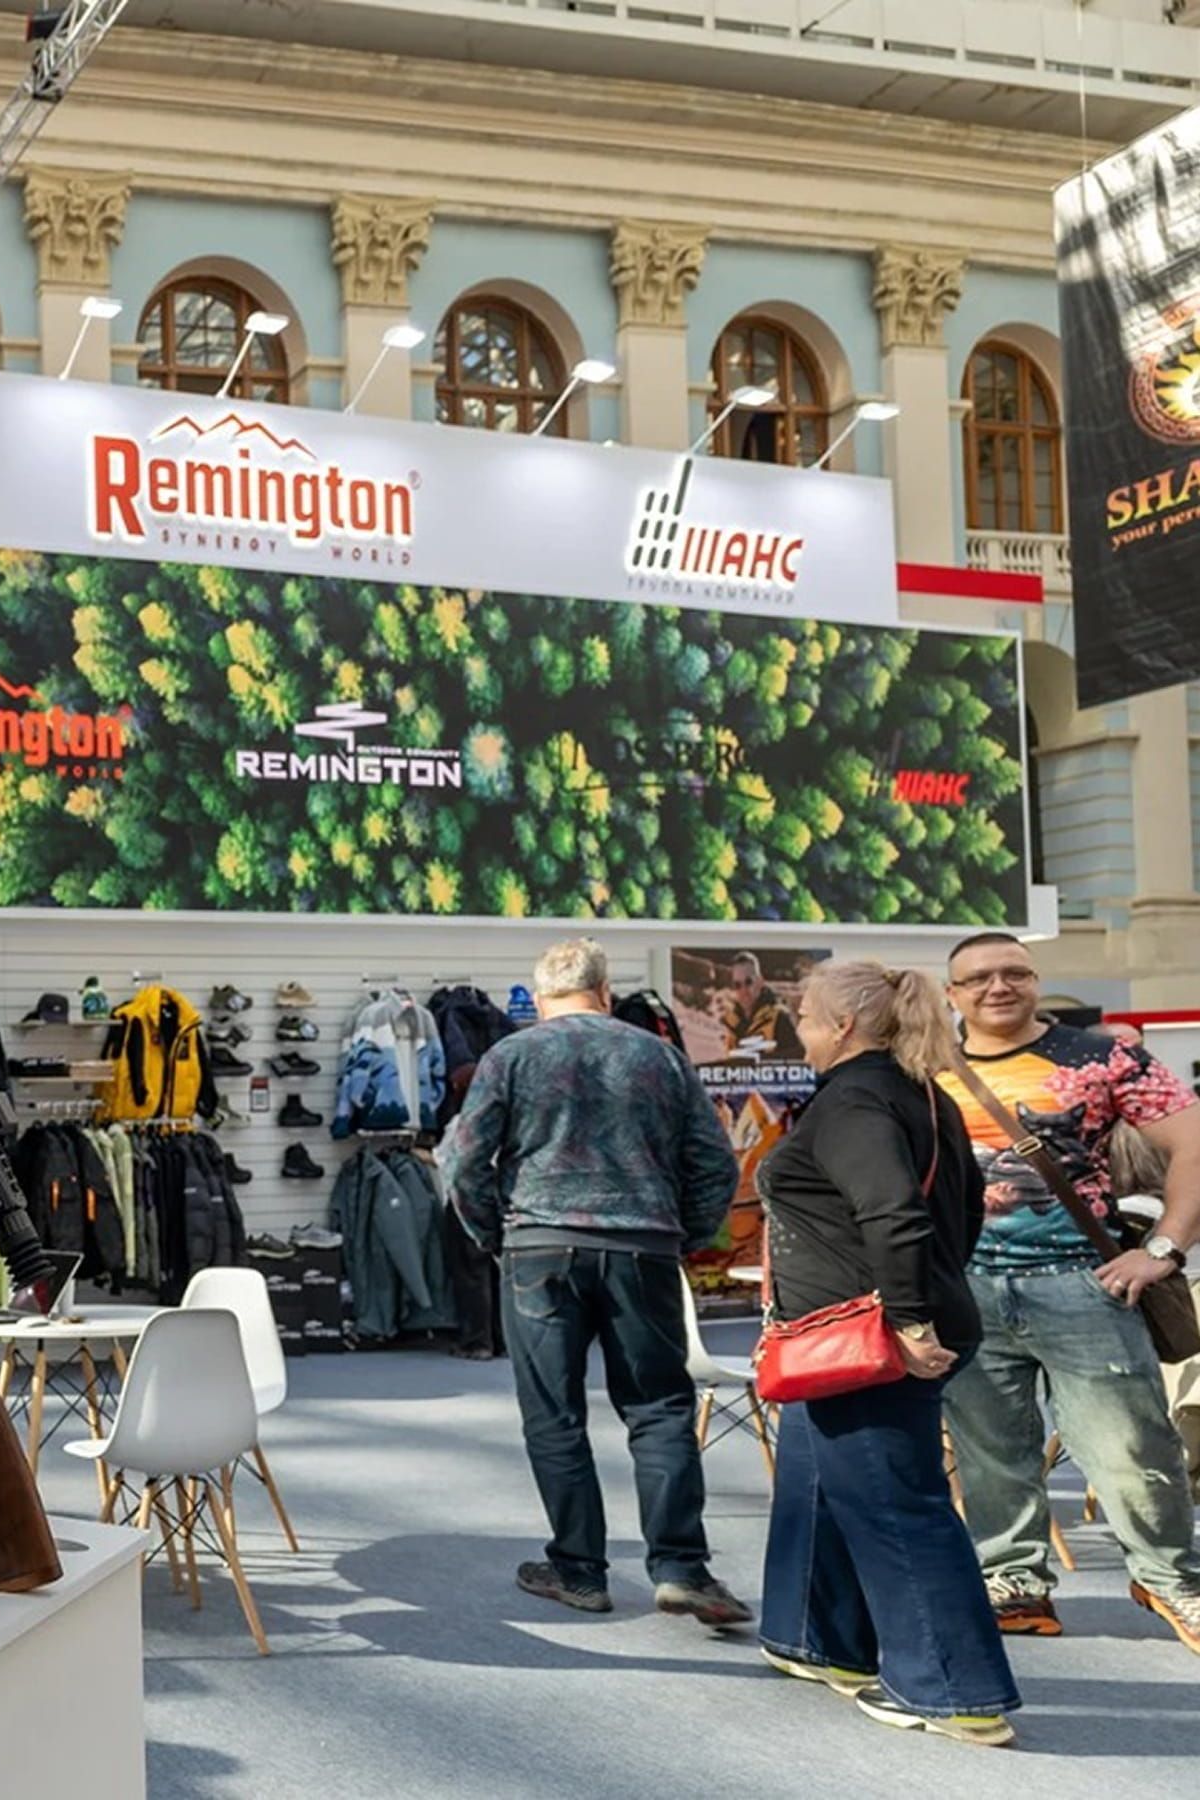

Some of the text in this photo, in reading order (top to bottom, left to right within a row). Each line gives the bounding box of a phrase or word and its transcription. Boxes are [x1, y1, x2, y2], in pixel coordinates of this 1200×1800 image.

[94, 436, 412, 540] Remington
[161, 528, 411, 566] SYNERGY WORLD
[1112, 522, 1156, 552] your
[236, 750, 462, 788] REMINGTON
[699, 1065, 815, 1083] REMINGTON
